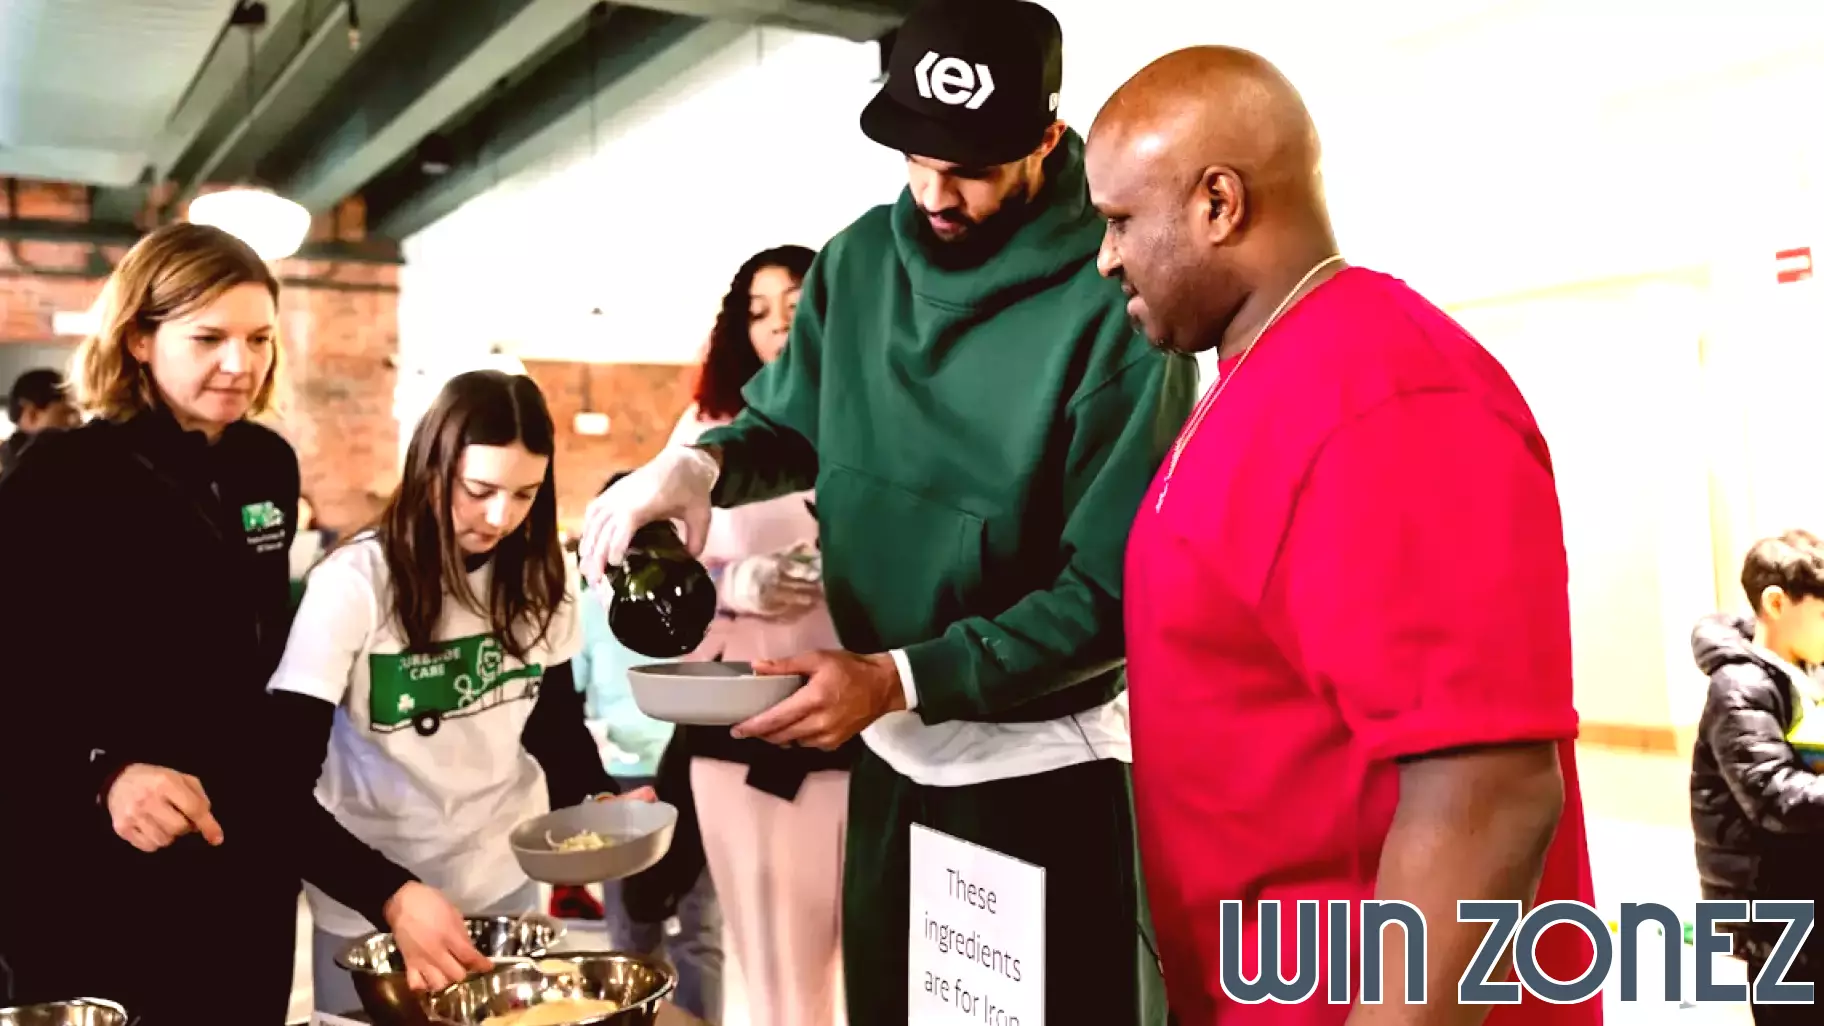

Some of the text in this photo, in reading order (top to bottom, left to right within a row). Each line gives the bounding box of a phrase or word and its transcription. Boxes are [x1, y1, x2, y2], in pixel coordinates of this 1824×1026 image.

[410, 664, 444, 680] CARE
[946, 868, 997, 914] These
[925, 911, 1021, 982] ingredients
[925, 970, 949, 1002] are
[954, 978, 979, 1016] for
